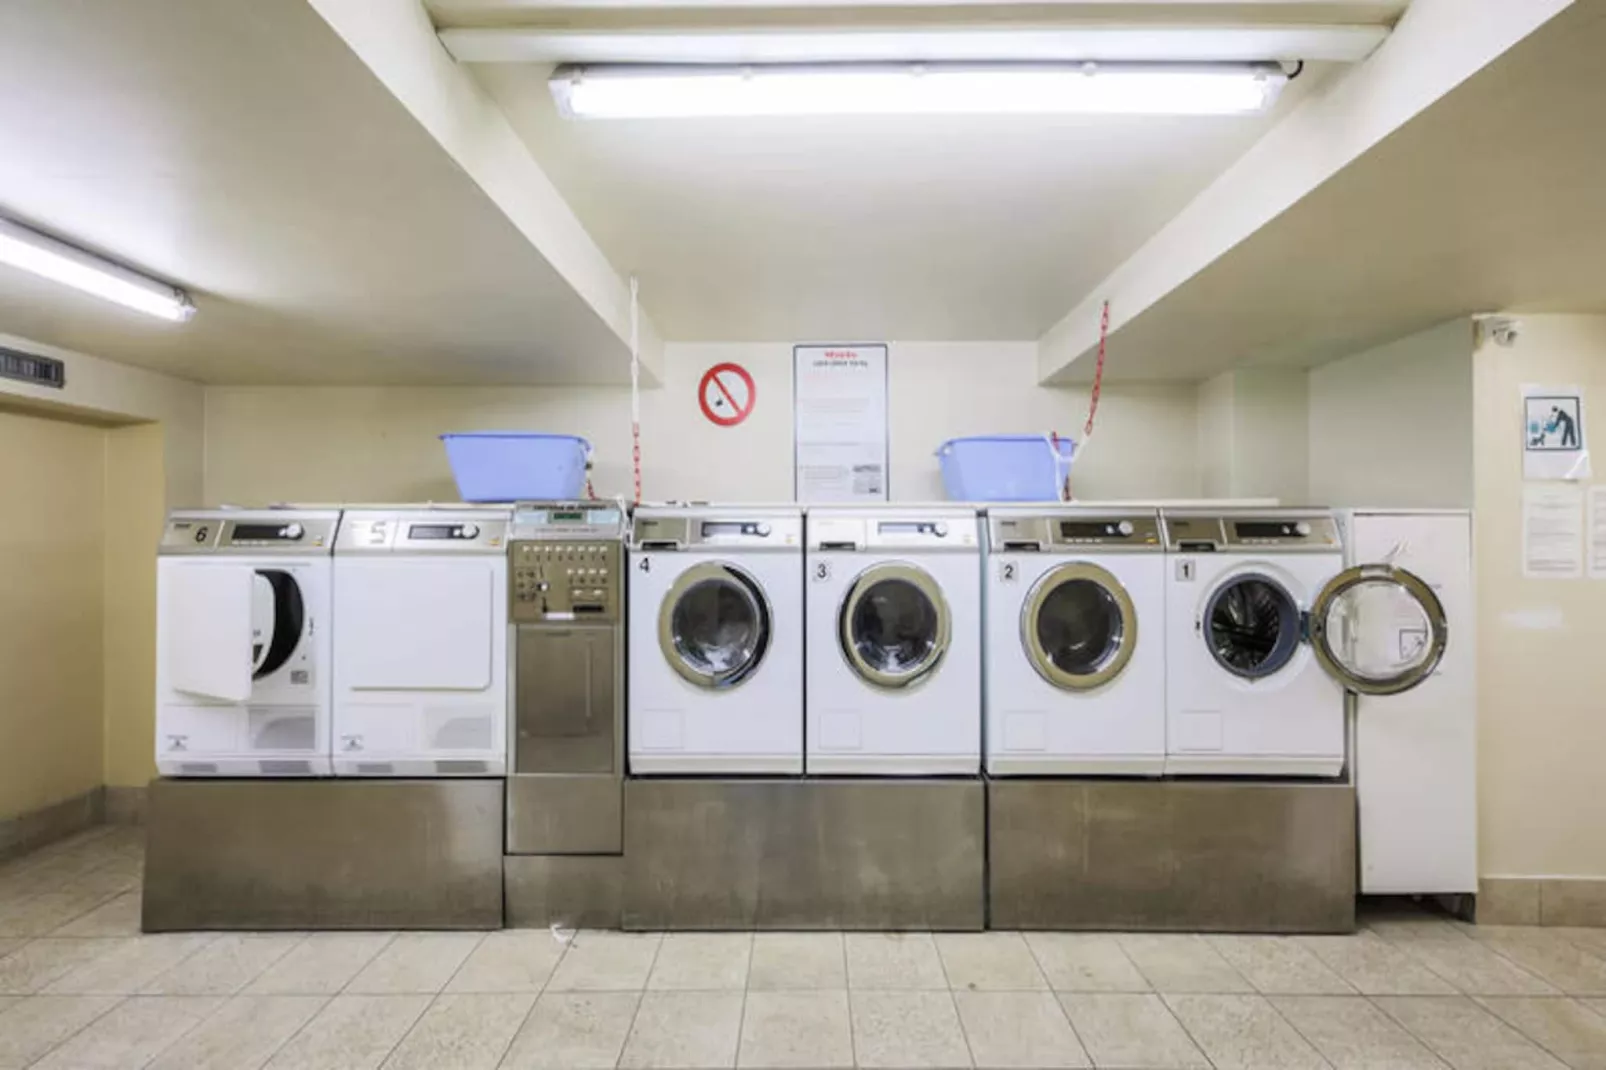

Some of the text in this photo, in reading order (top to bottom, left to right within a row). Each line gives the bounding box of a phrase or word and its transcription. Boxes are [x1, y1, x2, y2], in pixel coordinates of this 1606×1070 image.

[195, 526, 208, 543] 6
[639, 557, 649, 573] 4
[817, 563, 827, 579] 3
[1004, 563, 1014, 579] 2
